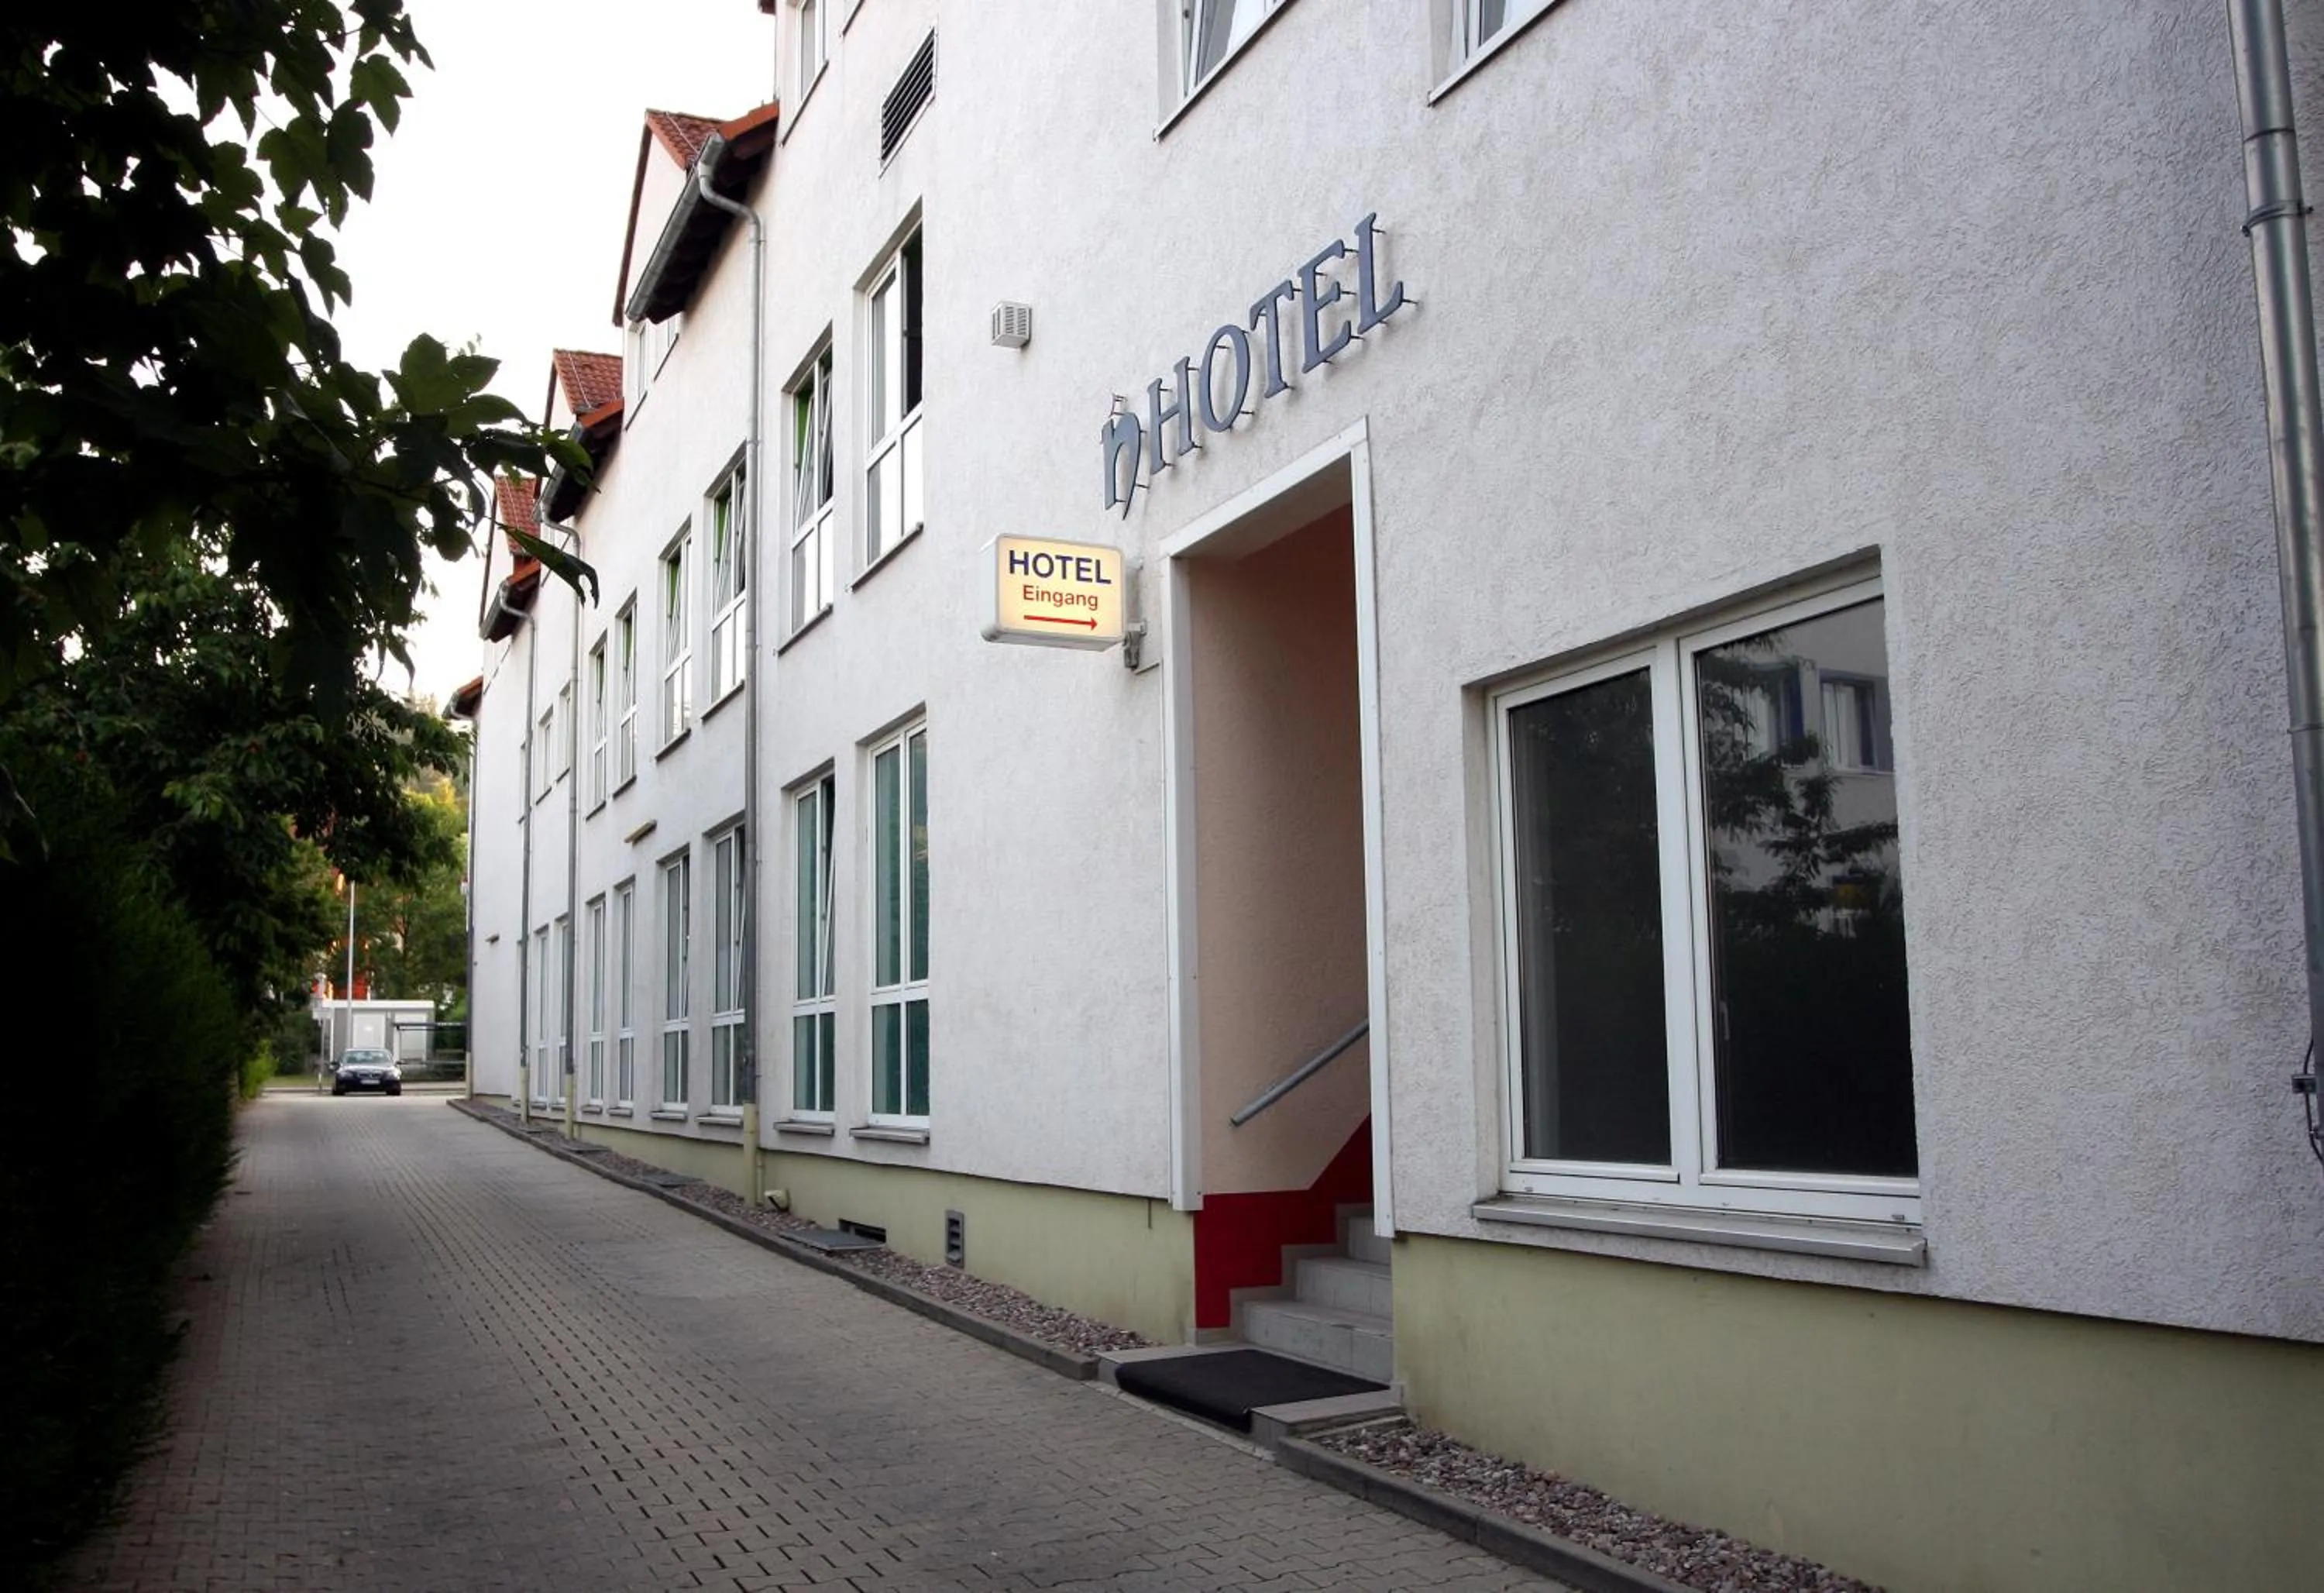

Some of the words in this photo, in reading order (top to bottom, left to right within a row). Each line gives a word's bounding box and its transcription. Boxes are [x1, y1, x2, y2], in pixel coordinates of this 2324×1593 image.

[1147, 212, 1404, 475] HOTEL
[1009, 549, 1112, 584] HOTEL
[1022, 584, 1098, 611] Eingang
